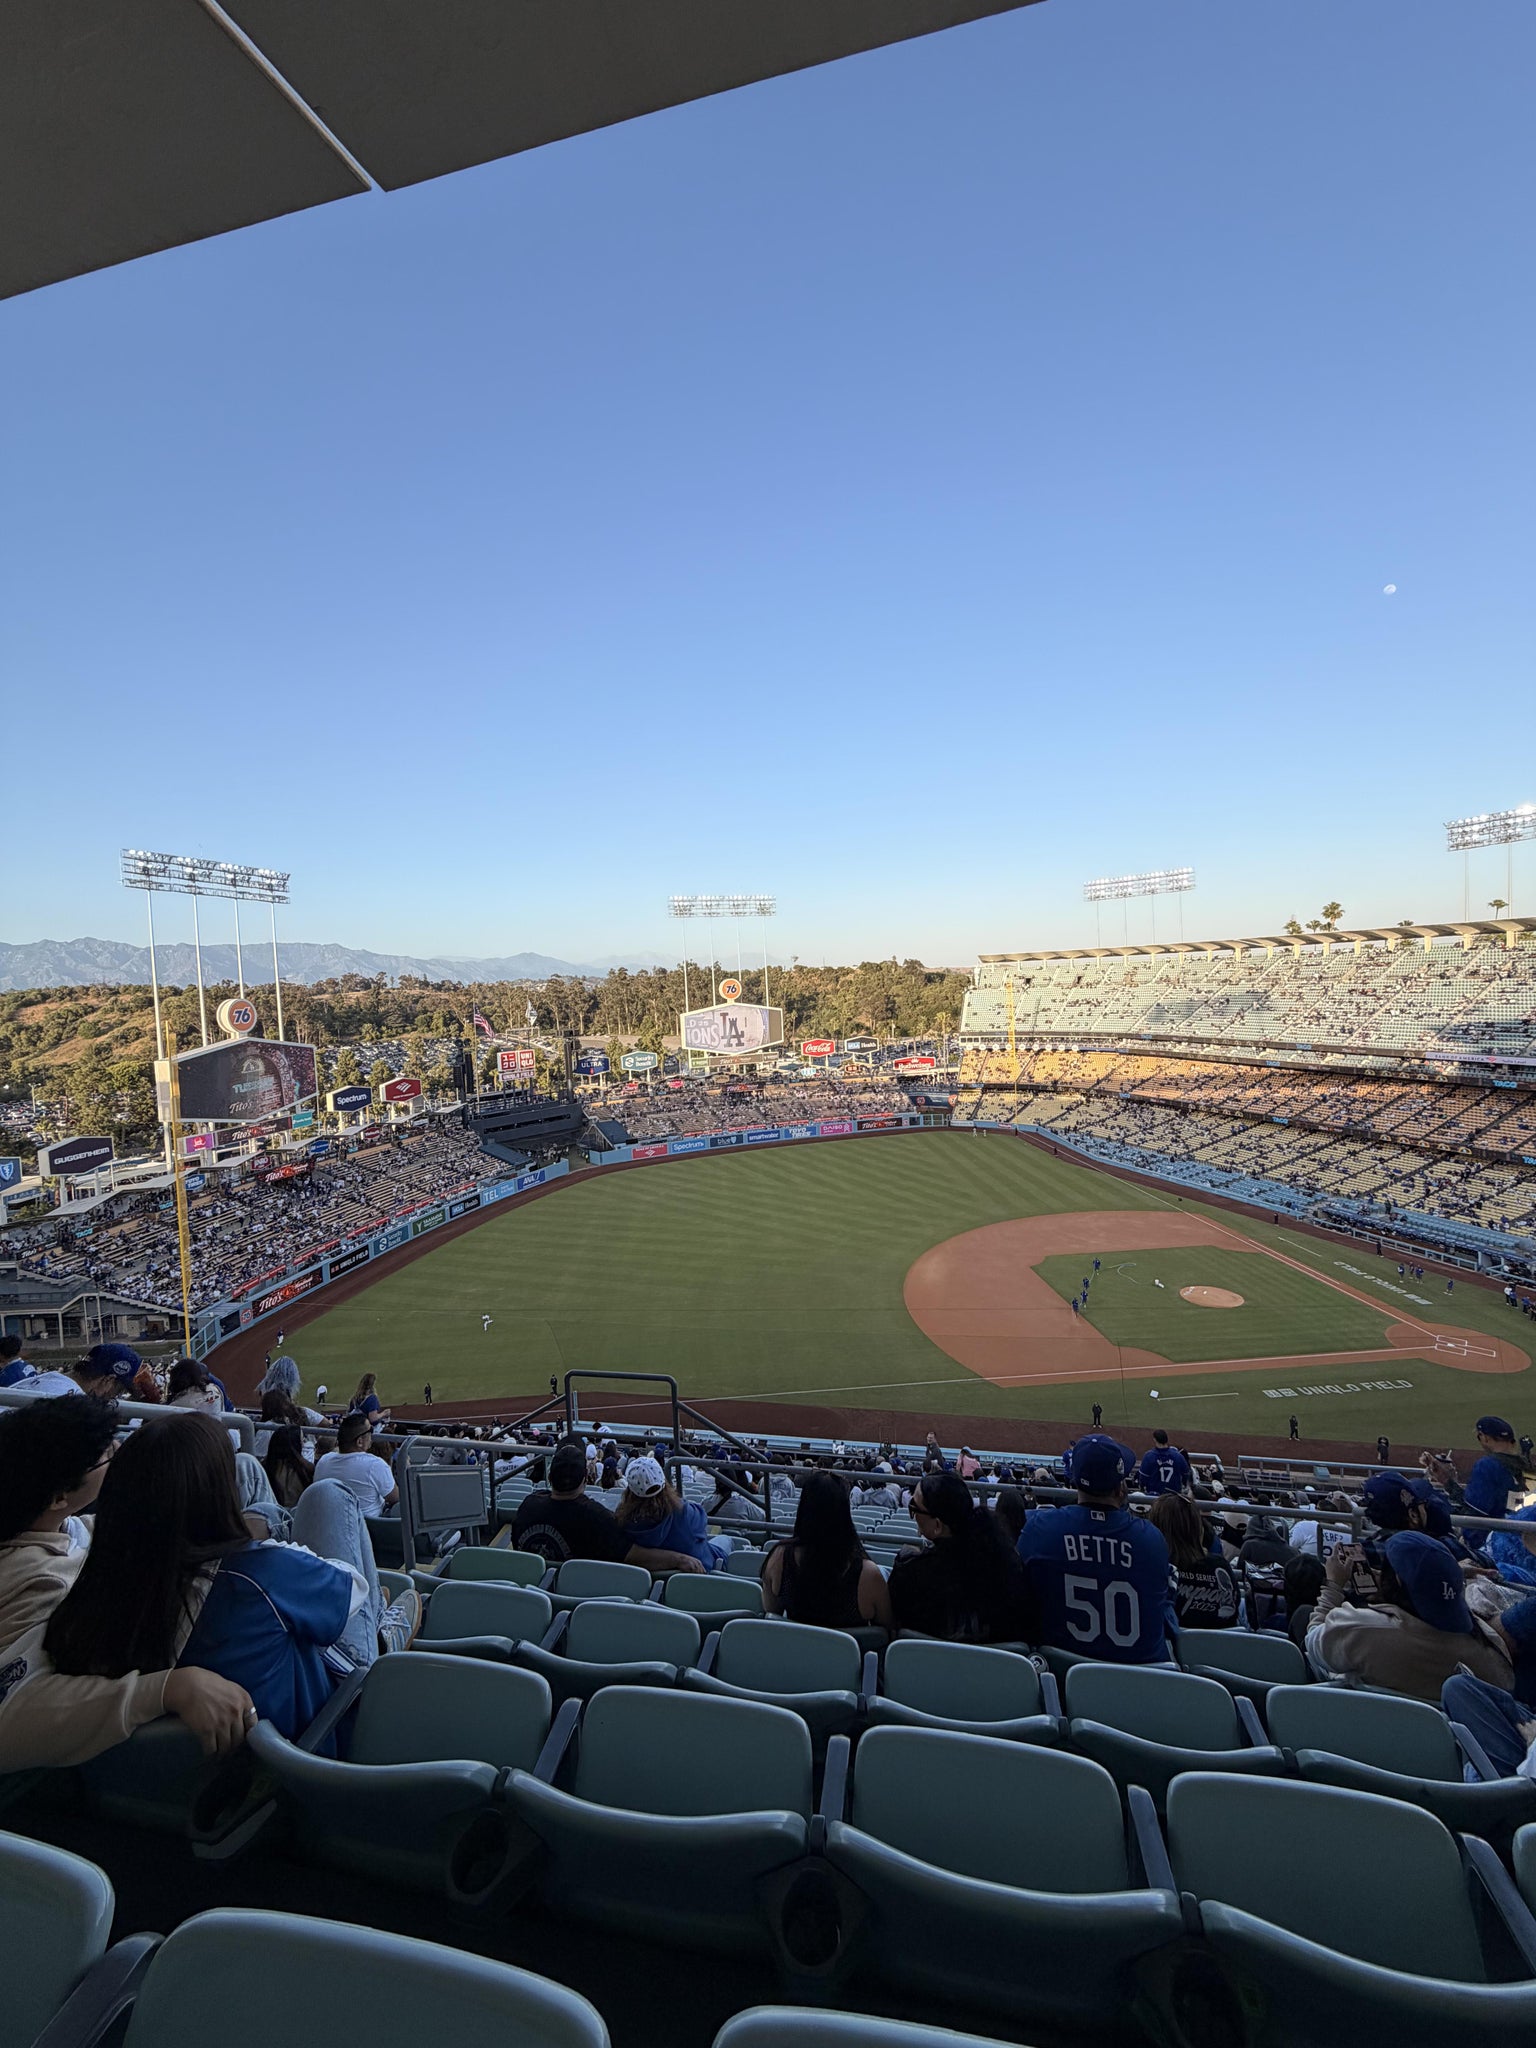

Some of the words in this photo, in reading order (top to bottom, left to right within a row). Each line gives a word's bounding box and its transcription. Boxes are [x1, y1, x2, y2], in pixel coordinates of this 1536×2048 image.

[726, 984, 737, 994] 76
[233, 1006, 251, 1024] 76
[805, 1042, 832, 1054] Coca-Cola
[521, 1059, 534, 1067] QLO
[1492, 1079, 1518, 1089] TACO
[337, 1093, 367, 1106] Spectrum
[229, 1100, 253, 1114] Tito's
[1272, 1116, 1289, 1125] TACO
[232, 1129, 251, 1141] Tito's
[750, 1131, 779, 1141] smartwater
[673, 1141, 701, 1152] Spectrum
[54, 1147, 110, 1165] GUGGENHEIM
[265, 1170, 285, 1183] Tito's
[485, 1190, 499, 1202] TEL
[355, 1249, 369, 1261] FIELD
[258, 1291, 284, 1313] Tito's
[1296, 1383, 1361, 1395] UNIQLO
[1360, 1379, 1414, 1391] FIELD
[1159, 1466, 1174, 1483] 17
[1064, 1535, 1133, 1568] BETTS
[1195, 1573, 1216, 1583] SERIES
[1442, 1581, 1457, 1600] LA
[1064, 1573, 1141, 1647] 50
[1190, 1601, 1217, 1612] 2025
